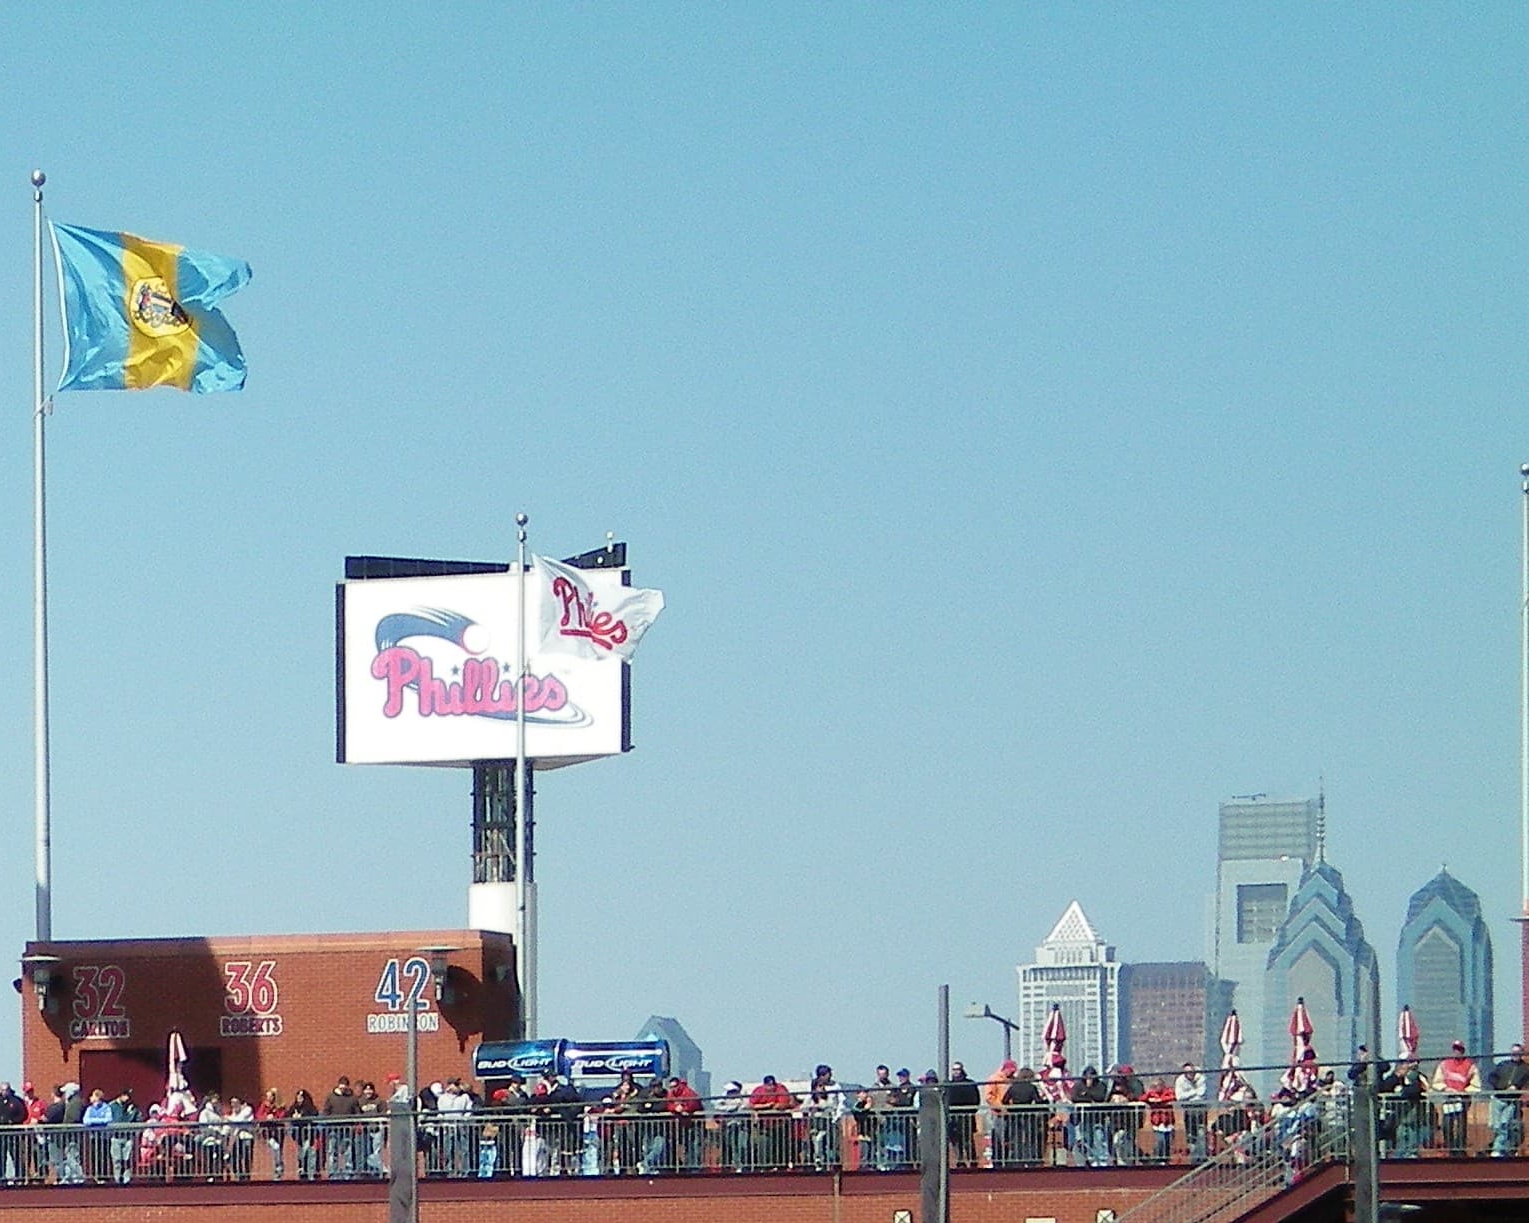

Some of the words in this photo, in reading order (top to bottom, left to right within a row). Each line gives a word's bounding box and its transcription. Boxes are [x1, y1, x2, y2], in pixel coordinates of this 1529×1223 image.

[371, 646, 568, 718] Phillies
[72, 965, 126, 1018] 32
[225, 961, 278, 1014] 36
[375, 957, 431, 1011] 42
[70, 1018, 130, 1039] CARLTON
[220, 1015, 283, 1036] ROBERTS
[367, 1013, 439, 1033] ROBINON
[477, 1061, 507, 1070] BUD
[513, 1058, 552, 1068] LIGHT
[611, 1059, 653, 1068] LIGHT
